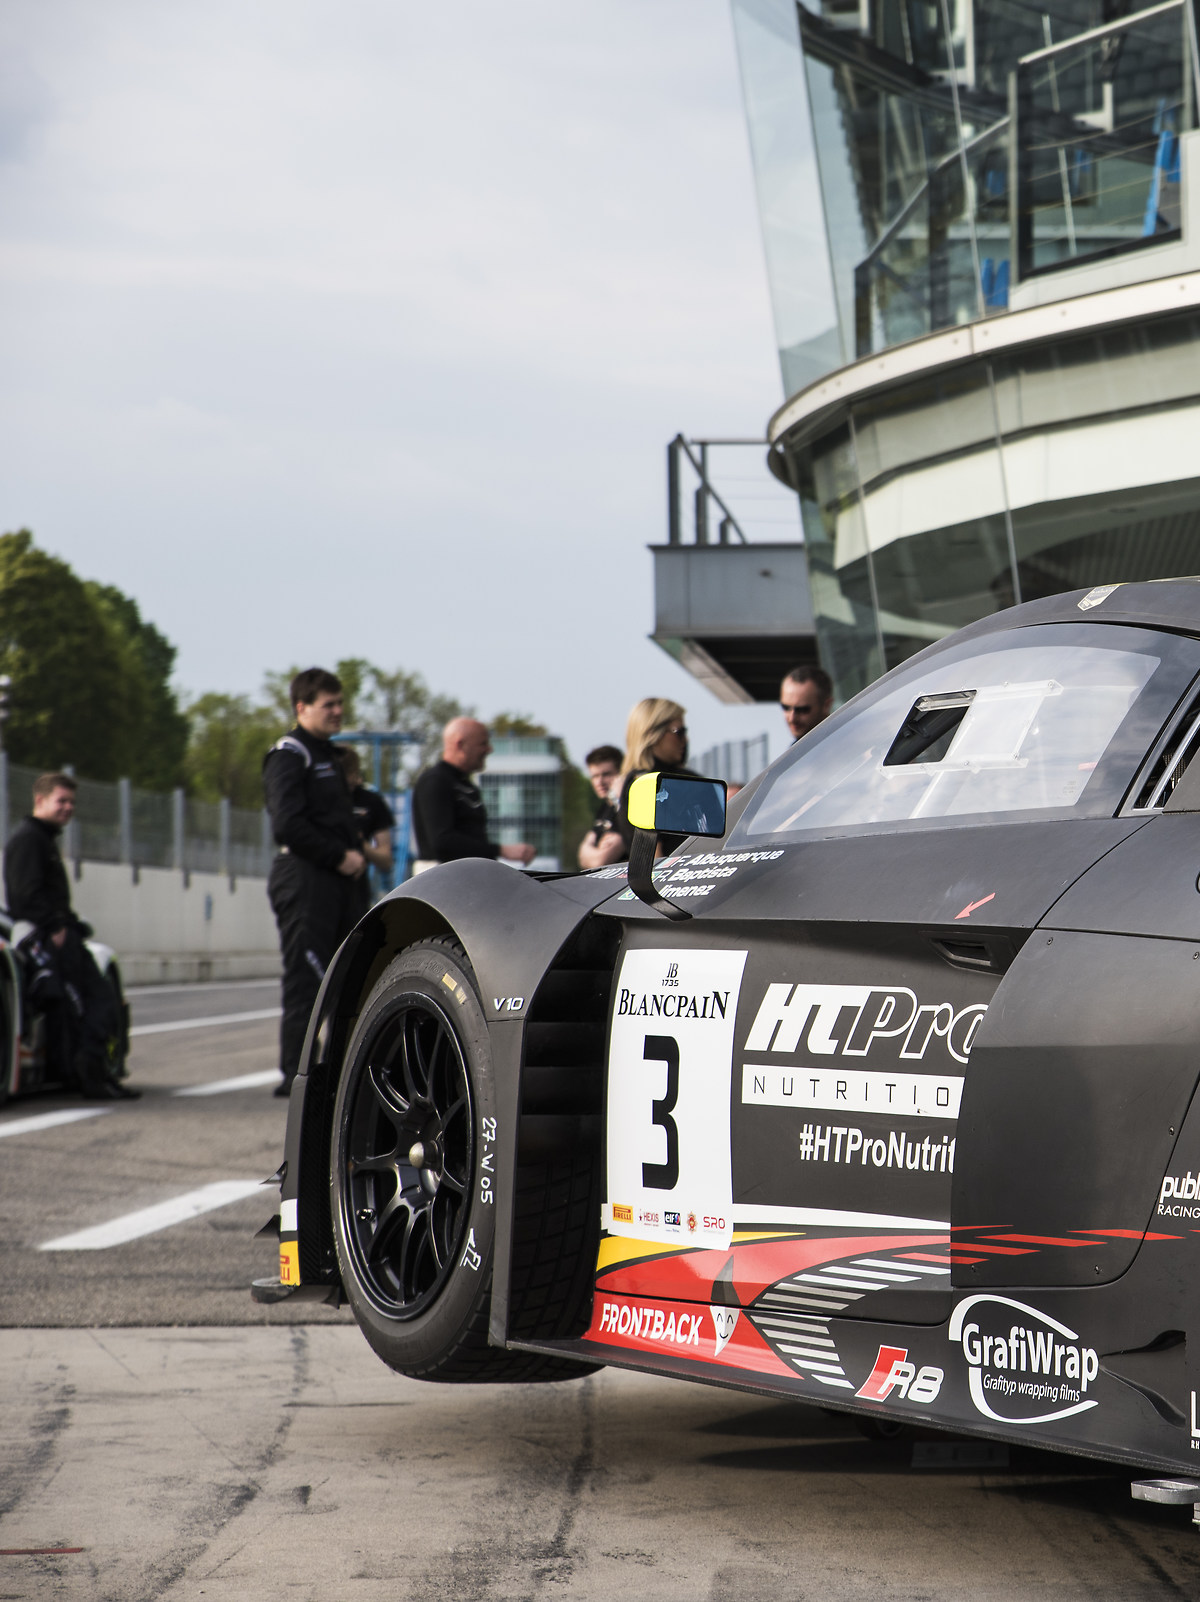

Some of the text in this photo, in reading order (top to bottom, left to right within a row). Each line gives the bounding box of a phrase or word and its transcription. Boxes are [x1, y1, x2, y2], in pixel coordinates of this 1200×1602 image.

[684, 849, 785, 867] Albuquerque
[667, 865, 738, 883] Baptista
[661, 979, 680, 987] 1735
[493, 997, 525, 1012] V10
[617, 988, 731, 1020] BLANCPAIN
[753, 1075, 950, 1107] NUTRITIO
[642, 1034, 681, 1190] 3
[613, 1206, 632, 1221] PIRELLI
[665, 1213, 675, 1224] elf
[1157, 1203, 1200, 1219] RACING
[703, 1216, 726, 1230] SRO
[598, 1303, 704, 1346] FRONTBACK
[962, 1323, 1099, 1392] GrafiWrap
[878, 1360, 945, 1404] R8
[983, 1373, 1081, 1402] Grafityp wrapping films
